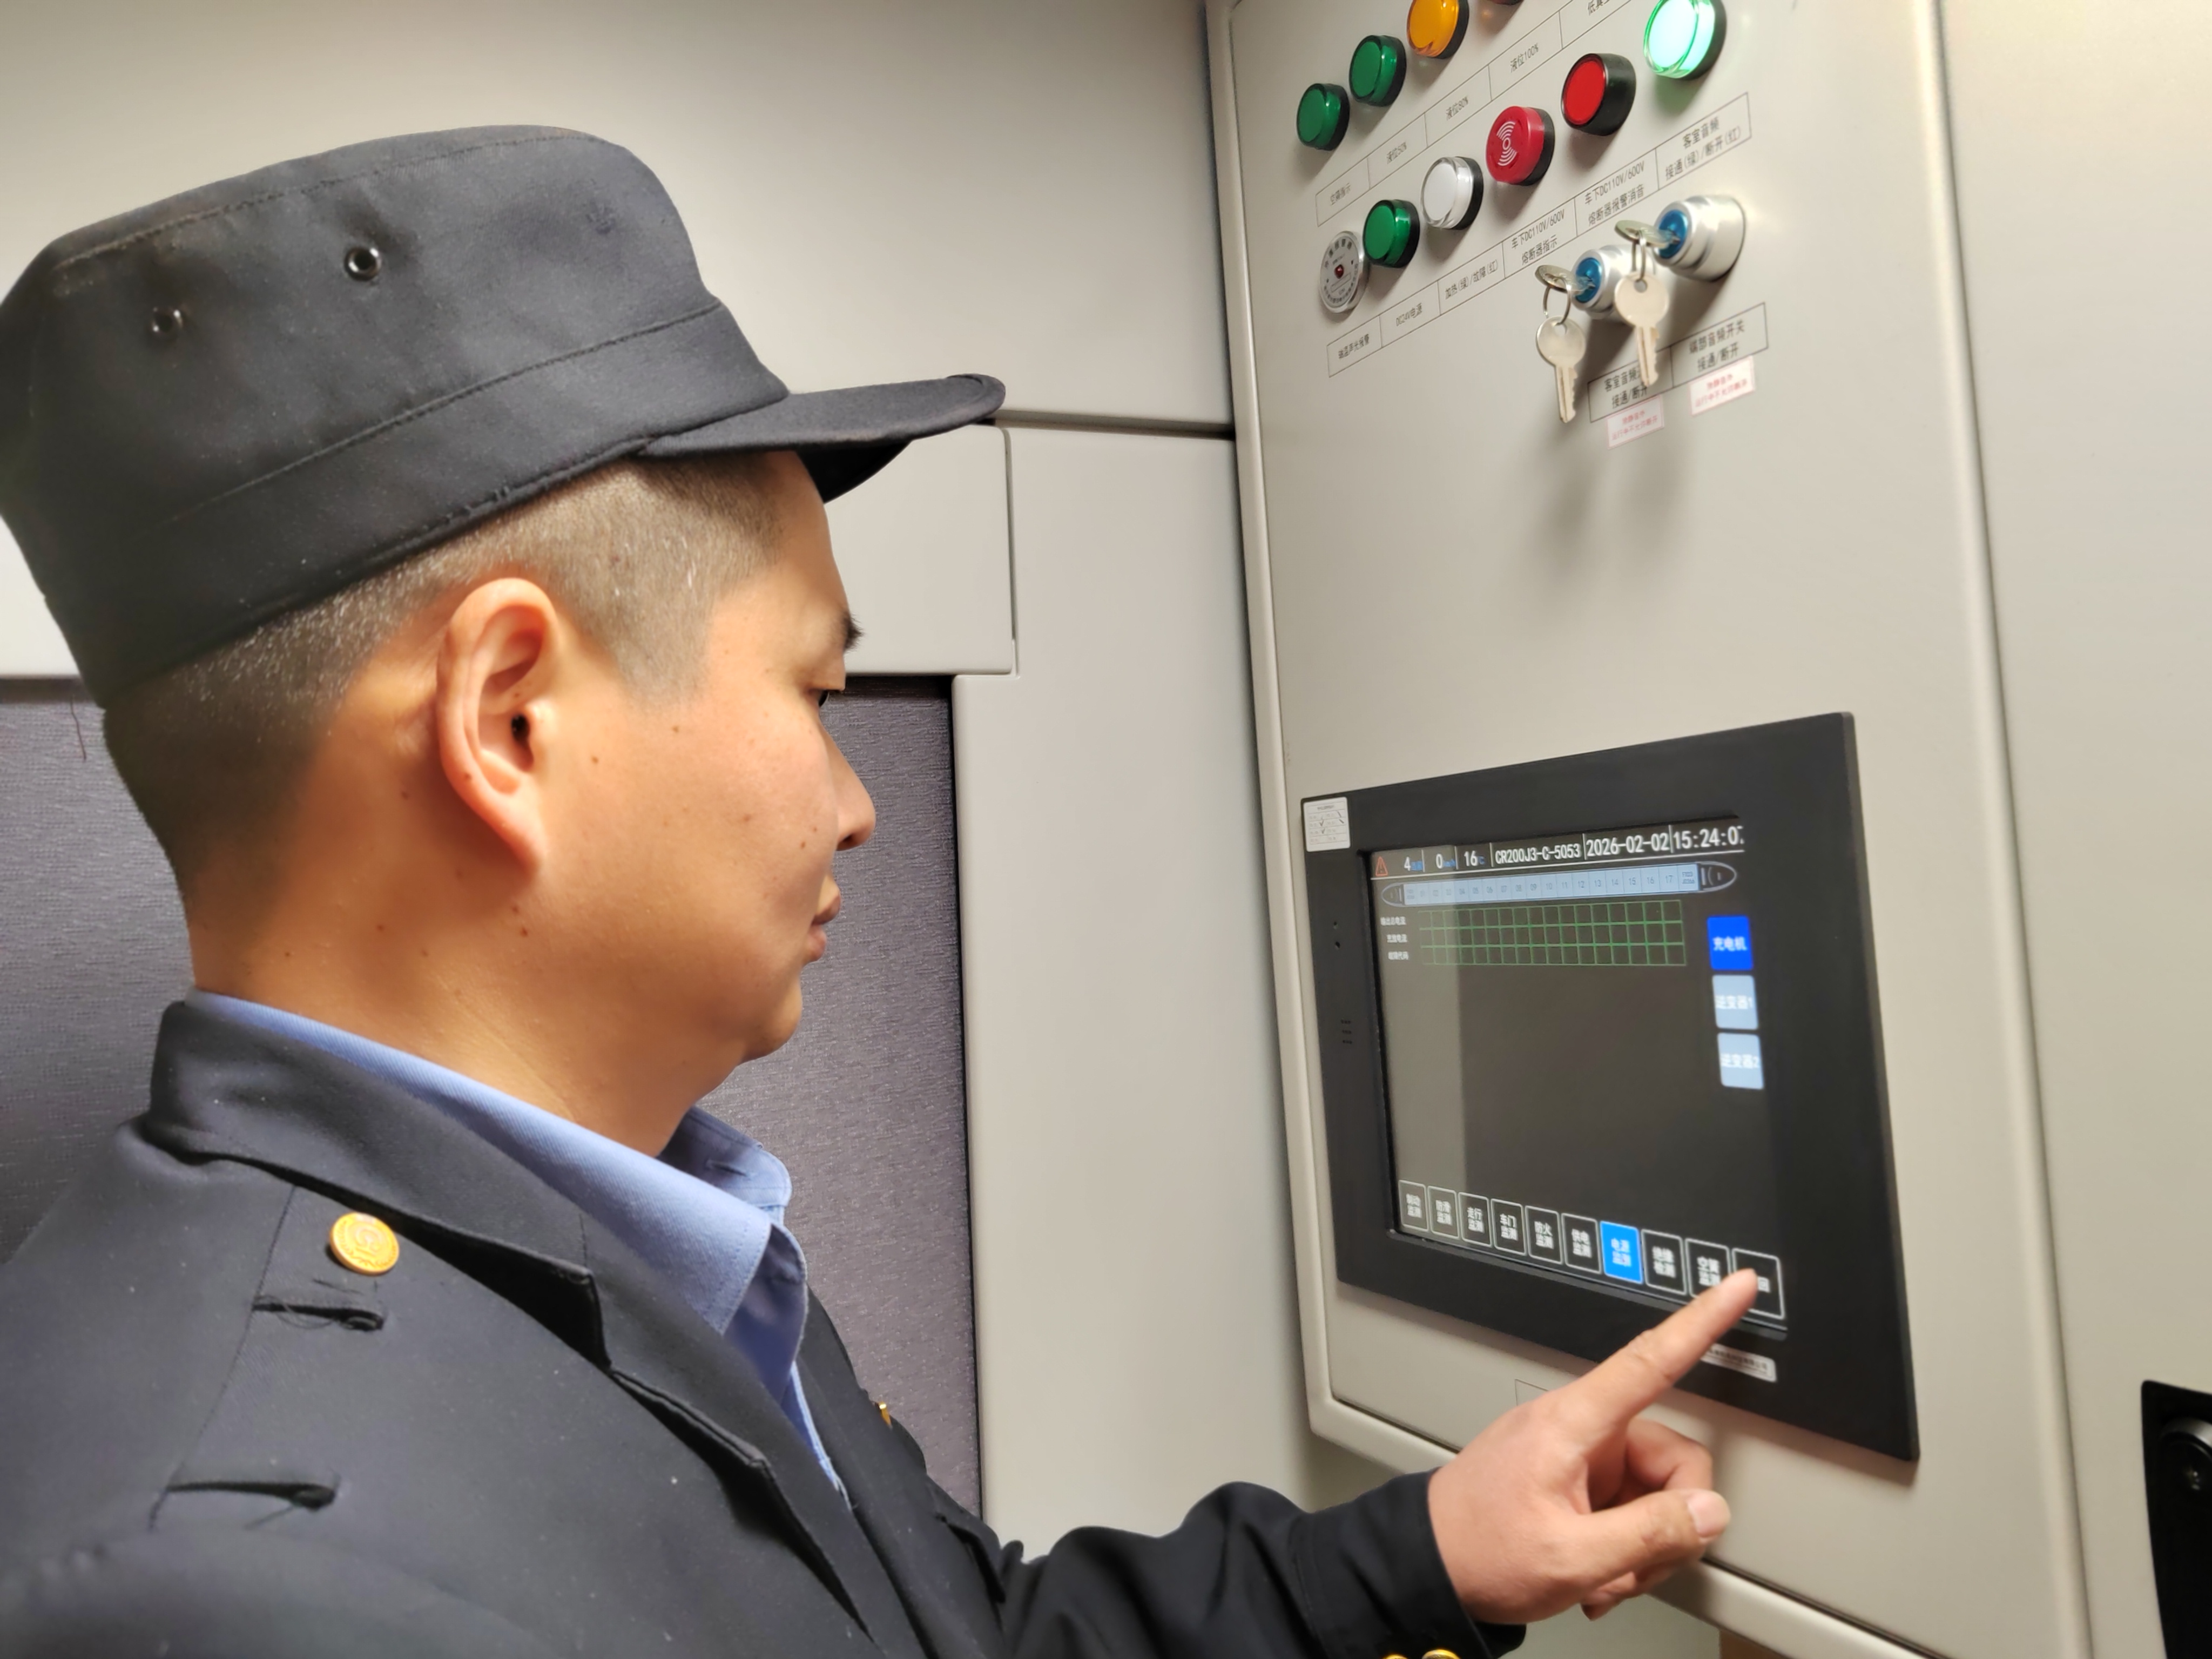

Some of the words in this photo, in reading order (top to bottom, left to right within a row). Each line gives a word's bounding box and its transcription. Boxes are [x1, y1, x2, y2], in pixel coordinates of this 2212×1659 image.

[1587, 0, 1610, 16] 低真
[1510, 43, 1539, 72] 液位100%
[1682, 116, 1721, 149] 客室音频
[1584, 161, 1644, 205] 车下DC110V/600V
[1588, 184, 1644, 227] 熔断器报警消音
[1512, 209, 1564, 249] 车下DC110V/600V
[1522, 234, 1557, 265] 熔断器指示
[1689, 319, 1745, 354] 端部音频开关
[1697, 342, 1739, 372] 接通/断开
[1604, 365, 1640, 393] 客室音频
[1586, 832, 1670, 857] 2026-02-02
[1436, 853, 1443, 869] 0
[1464, 850, 1478, 866] 16
[1495, 843, 1581, 864] CR200J3-C-5053
[1404, 857, 1411, 871] 4
[1594, 879, 1601, 887] 13
[1611, 878, 1618, 886] 14
[1629, 877, 1636, 886] 15
[1647, 876, 1654, 885] 16
[1665, 875, 1674, 884] 17
[1712, 936, 1748, 952] 充电机
[1467, 1206, 1482, 1220] 走行
[1500, 1213, 1517, 1228] 车门
[1534, 1220, 1553, 1237] 防火
[1611, 1237, 1630, 1253] 电源
[1757, 1276, 1771, 1293] 回
